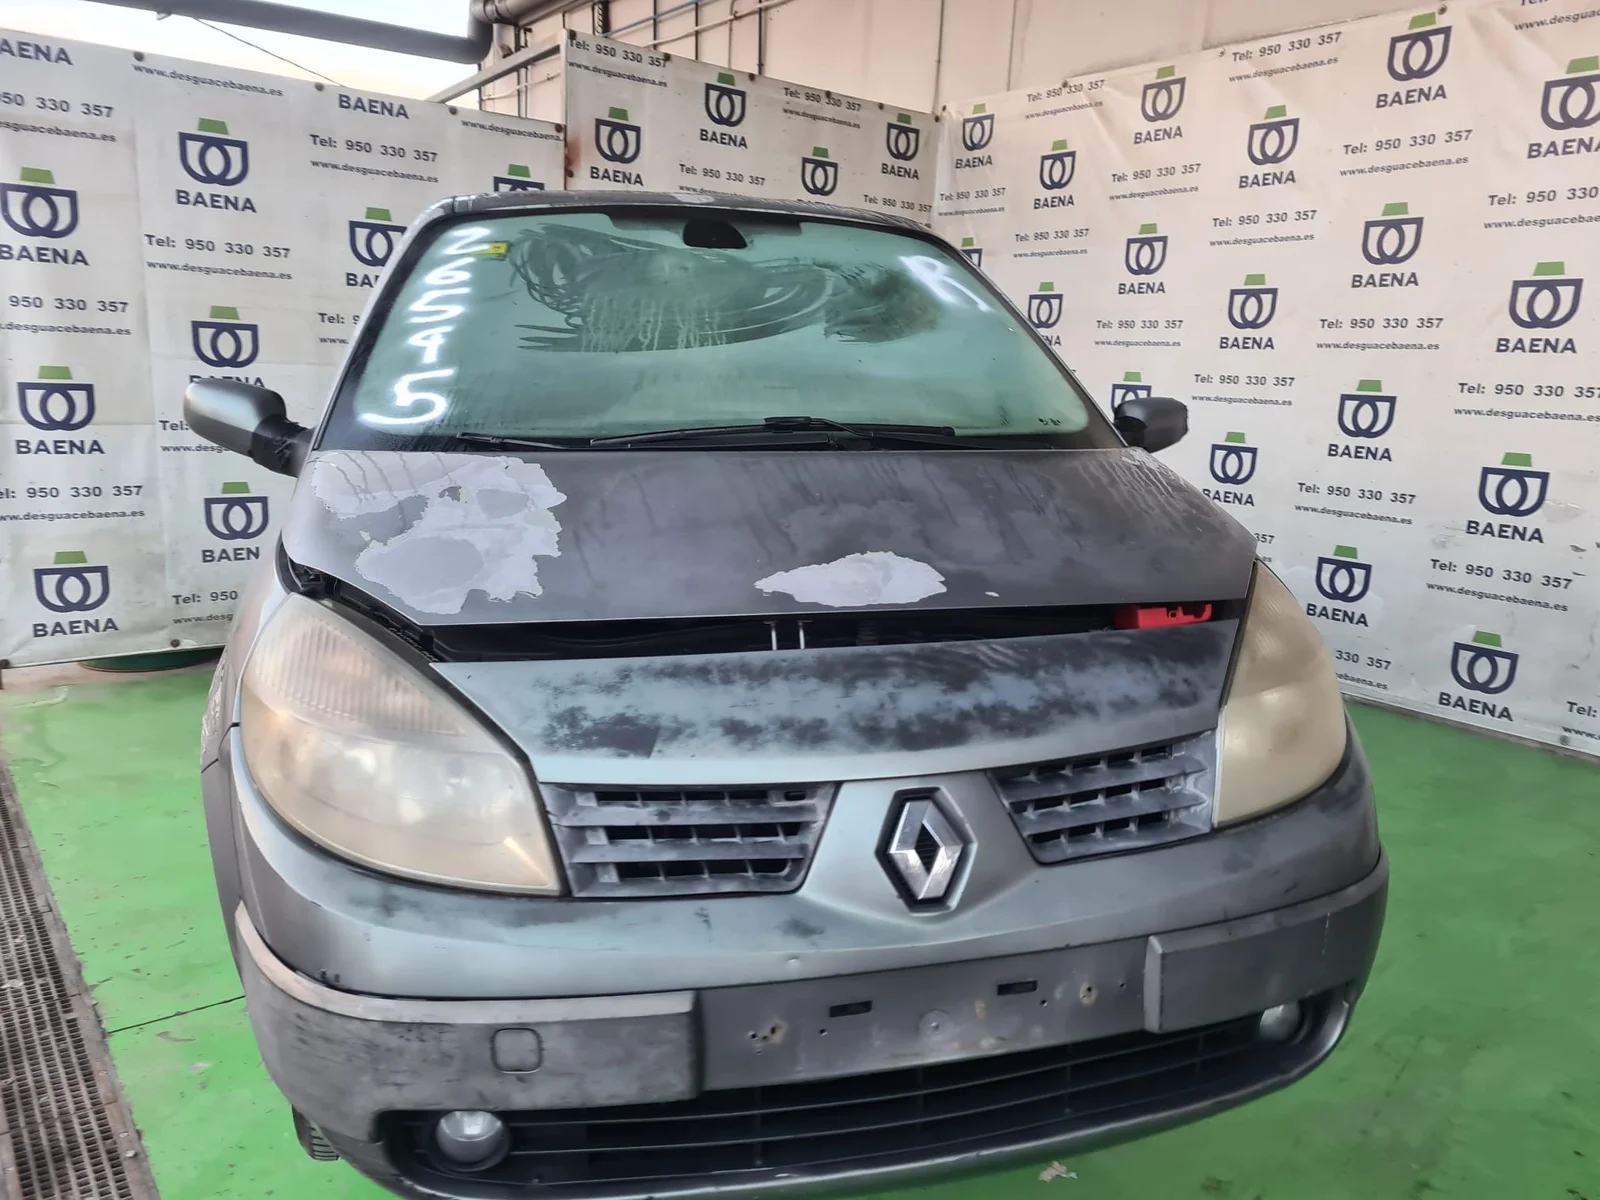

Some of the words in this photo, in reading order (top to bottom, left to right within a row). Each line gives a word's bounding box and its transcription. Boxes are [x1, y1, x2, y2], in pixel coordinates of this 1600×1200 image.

[596, 43, 617, 58] 950
[622, 49, 643, 63] 330
[1231, 51, 1252, 63] Tel:
[1258, 43, 1281, 58] 950
[1288, 38, 1311, 52] 330
[1318, 31, 1342, 47] 357
[1228, 56, 1339, 83] www.desguacebaena.es
[132, 63, 284, 98] www.desguacebaena.es
[784, 87, 801, 99] Tel:
[845, 101, 862, 112] 357
[1027, 92, 1043, 103] Tel:
[1046, 87, 1063, 99] 950
[1066, 82, 1084, 95] 330
[1088, 79, 1105, 92] 357
[1375, 84, 1448, 109] BAENA
[0, 91, 25, 106] 50
[35, 96, 70, 112] 330
[80, 102, 115, 118] 357
[338, 93, 409, 119] BAENA
[699, 128, 748, 149] BAENA
[1133, 125, 1183, 144] BAENA
[1342, 143, 1367, 155] Tel:
[1374, 138, 1402, 152] 950
[1408, 133, 1436, 147] 330
[1444, 129, 1473, 143] 357
[310, 134, 337, 149] Tel:
[345, 139, 372, 153] 950
[380, 144, 406, 158] 330
[413, 149, 438, 163] 357
[310, 159, 439, 183] www.desguacebaena.es
[881, 162, 920, 181] BAENA
[955, 154, 993, 170] BAENA
[1339, 155, 1469, 177] www.desguacebaena.es
[590, 166, 644, 187] BAENA
[679, 163, 698, 175] Tel:
[702, 167, 721, 180] 950
[726, 171, 744, 184] 330
[748, 175, 766, 187] 357
[1111, 173, 1128, 183] Tel:
[1132, 169, 1152, 181] 950
[1156, 166, 1176, 178] 330
[1181, 163, 1202, 175] 357
[1238, 169, 1297, 189] BAENA
[176, 189, 258, 214] BAENA
[956, 190, 971, 201] 950
[974, 189, 989, 200] 330
[992, 187, 1007, 197] 357
[1033, 194, 1075, 210] BAENA
[1488, 192, 1517, 206] Tel:
[1525, 189, 1557, 204] 950
[1566, 186, 1600, 200] 330
[1212, 217, 1232, 228] Tel:
[1238, 214, 1260, 226] 950
[1266, 211, 1288, 224] 330
[1294, 209, 1318, 222] 357
[1014, 233, 1030, 243] Tel:
[1034, 231, 1050, 241] 950
[1053, 230, 1070, 240] 330
[1073, 228, 1090, 238] 357
[1209, 233, 1315, 247] www.desguacebaena.es
[0, 244, 90, 266] BAENA
[144, 234, 176, 248] Tel:
[185, 238, 215, 252] 950
[224, 242, 254, 256] 330
[262, 245, 291, 259] 357
[146, 260, 293, 281] www.desguacebaena.es
[1350, 271, 1420, 289] BAENA
[898, 254, 994, 313] R
[1117, 281, 1166, 295] BAENA
[8, 295, 43, 308] 950
[54, 297, 87, 311] 330
[97, 300, 129, 313] 357
[317, 312, 345, 324] Tel:
[1096, 319, 1113, 329] Tel:
[1117, 319, 1136, 330] 950
[1140, 319, 1159, 330] 330
[1164, 319, 1184, 330] 357
[1319, 318, 1344, 329] Tel:
[1350, 318, 1375, 329] 950
[1382, 317, 1409, 329] 330
[1416, 317, 1444, 329] 357
[0, 321, 132, 336] .desguacebaena.es
[1219, 336, 1275, 350] BAENA
[1316, 340, 1440, 351] www.desguacebaena.es
[1495, 337, 1578, 354] BAENA
[1194, 373, 1213, 384] Tel:
[1218, 375, 1239, 385] 950
[1245, 376, 1267, 386] 330
[1272, 376, 1296, 387] 357
[1457, 382, 1486, 394] Tel:
[1494, 383, 1524, 396] 950
[1532, 384, 1565, 397] 330
[159, 420, 189, 431] Tel:
[15, 439, 105, 455] BAENA
[1327, 443, 1393, 462] BAENA
[26, 486, 60, 499] 950
[70, 486, 103, 498] 330
[112, 484, 144, 497] 357
[1297, 481, 1321, 494] Tel:
[1326, 485, 1351, 497] 950
[1357, 488, 1383, 501] 330
[1389, 492, 1417, 505] 357
[1294, 504, 1413, 525] www.desguacebaena.es
[1466, 519, 1544, 544] BAENA
[1430, 558, 1457, 573] Tel:
[1465, 563, 1494, 578] 950
[1502, 569, 1532, 584] 330
[1541, 574, 1573, 590] 357
[171, 593, 201, 605] Tel:
[210, 590, 239, 602] 950
[1426, 581, 1569, 612] www.desguacebaena.es
[1306, 602, 1369, 628] BAENA
[32, 617, 119, 638] BAENA
[1335, 649, 1360, 664] 330
[1366, 656, 1392, 671] 357
[1438, 691, 1513, 722] BAENA
[1566, 700, 1597, 718] Tel:
